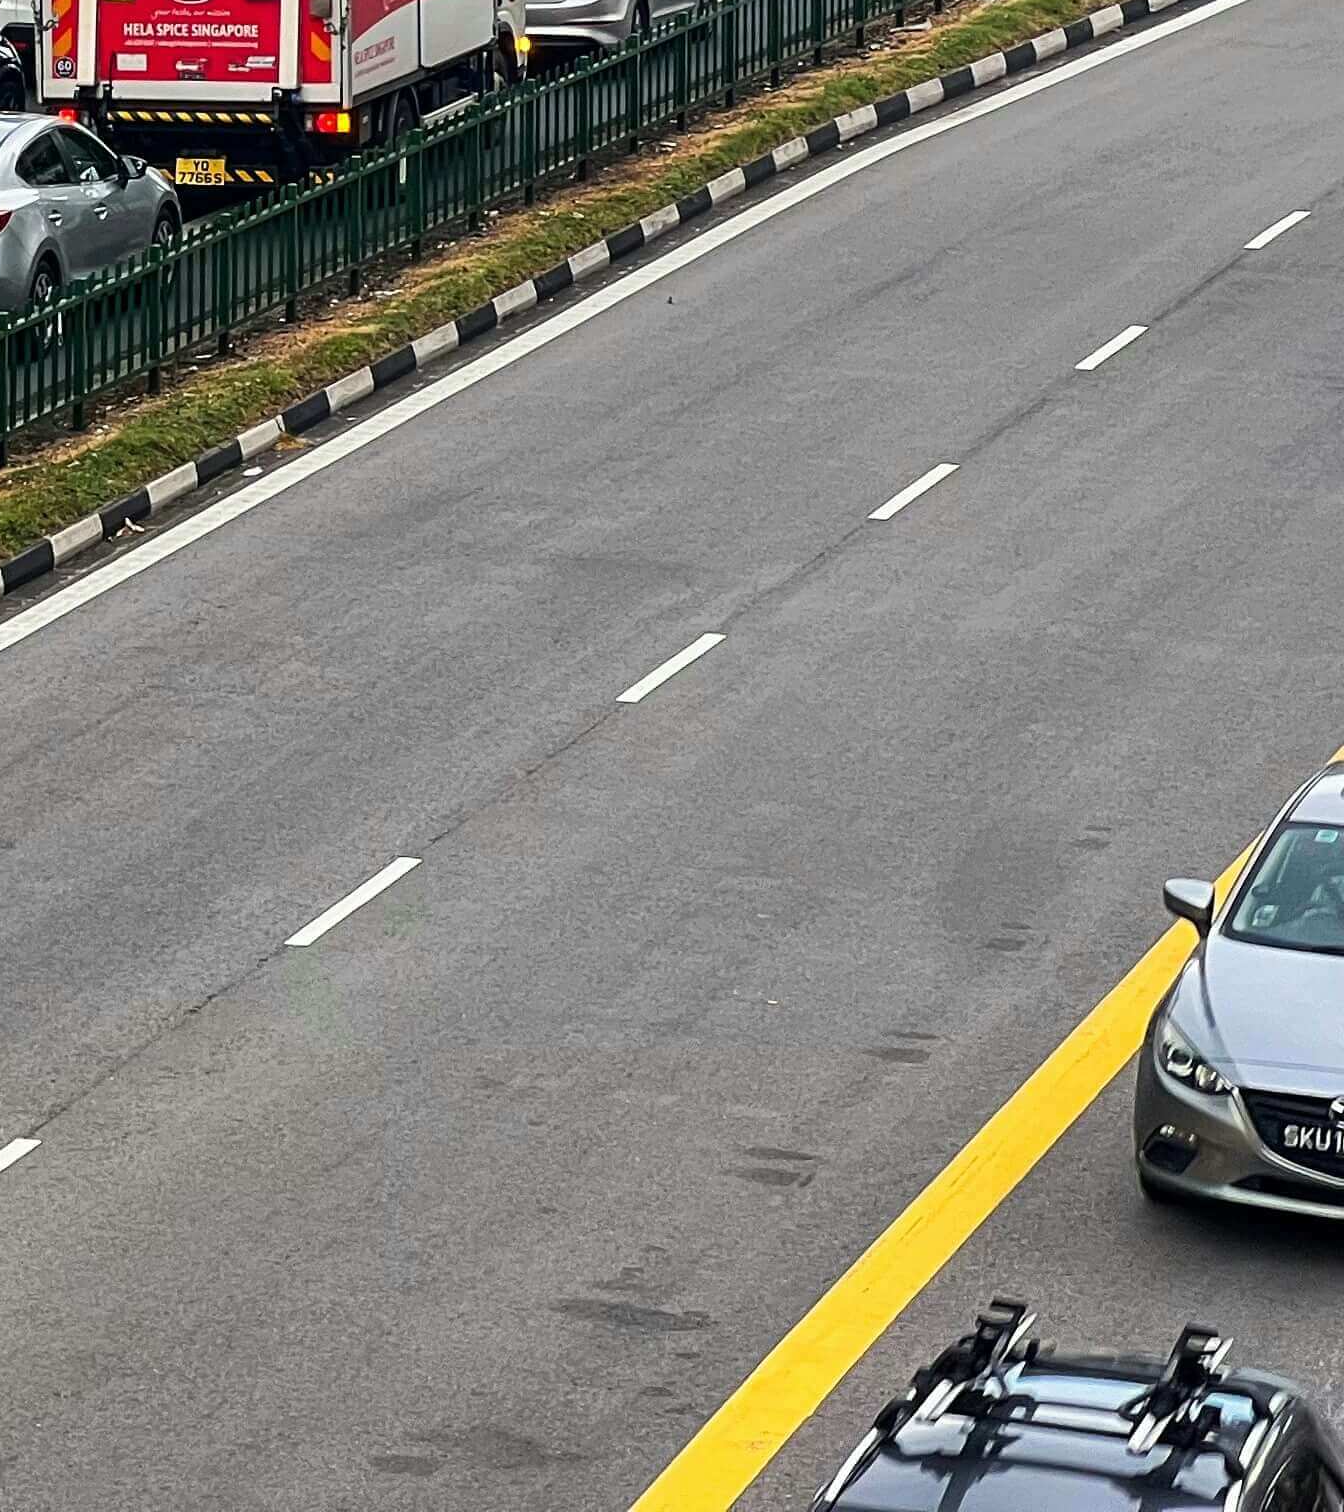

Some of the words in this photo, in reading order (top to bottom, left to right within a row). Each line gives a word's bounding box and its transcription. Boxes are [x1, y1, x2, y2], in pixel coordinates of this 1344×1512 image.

[123, 23, 155, 37] HELA
[155, 23, 189, 38] SPICE
[191, 23, 260, 39] SINGAPORE
[57, 60, 72, 72] 60
[178, 171, 223, 184] 7766S
[1283, 1124, 1344, 1153] SKU1
